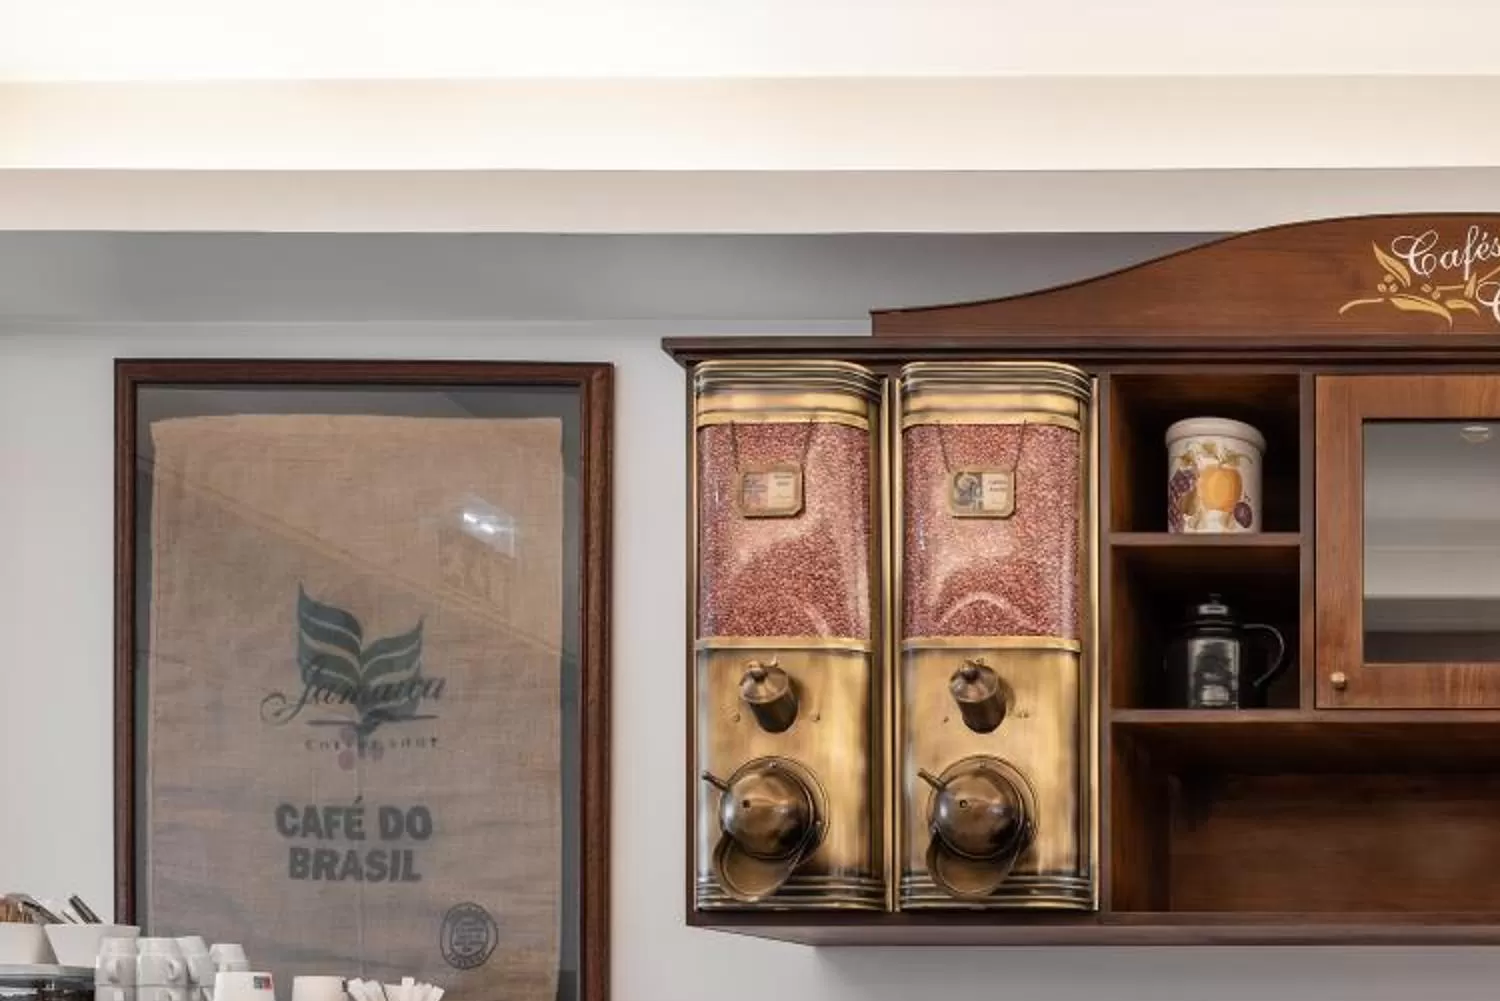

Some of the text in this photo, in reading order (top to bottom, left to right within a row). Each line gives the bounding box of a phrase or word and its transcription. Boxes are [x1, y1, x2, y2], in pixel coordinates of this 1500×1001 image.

[275, 795, 433, 841] CAFÉ DO
[289, 847, 423, 883] BRASIL
